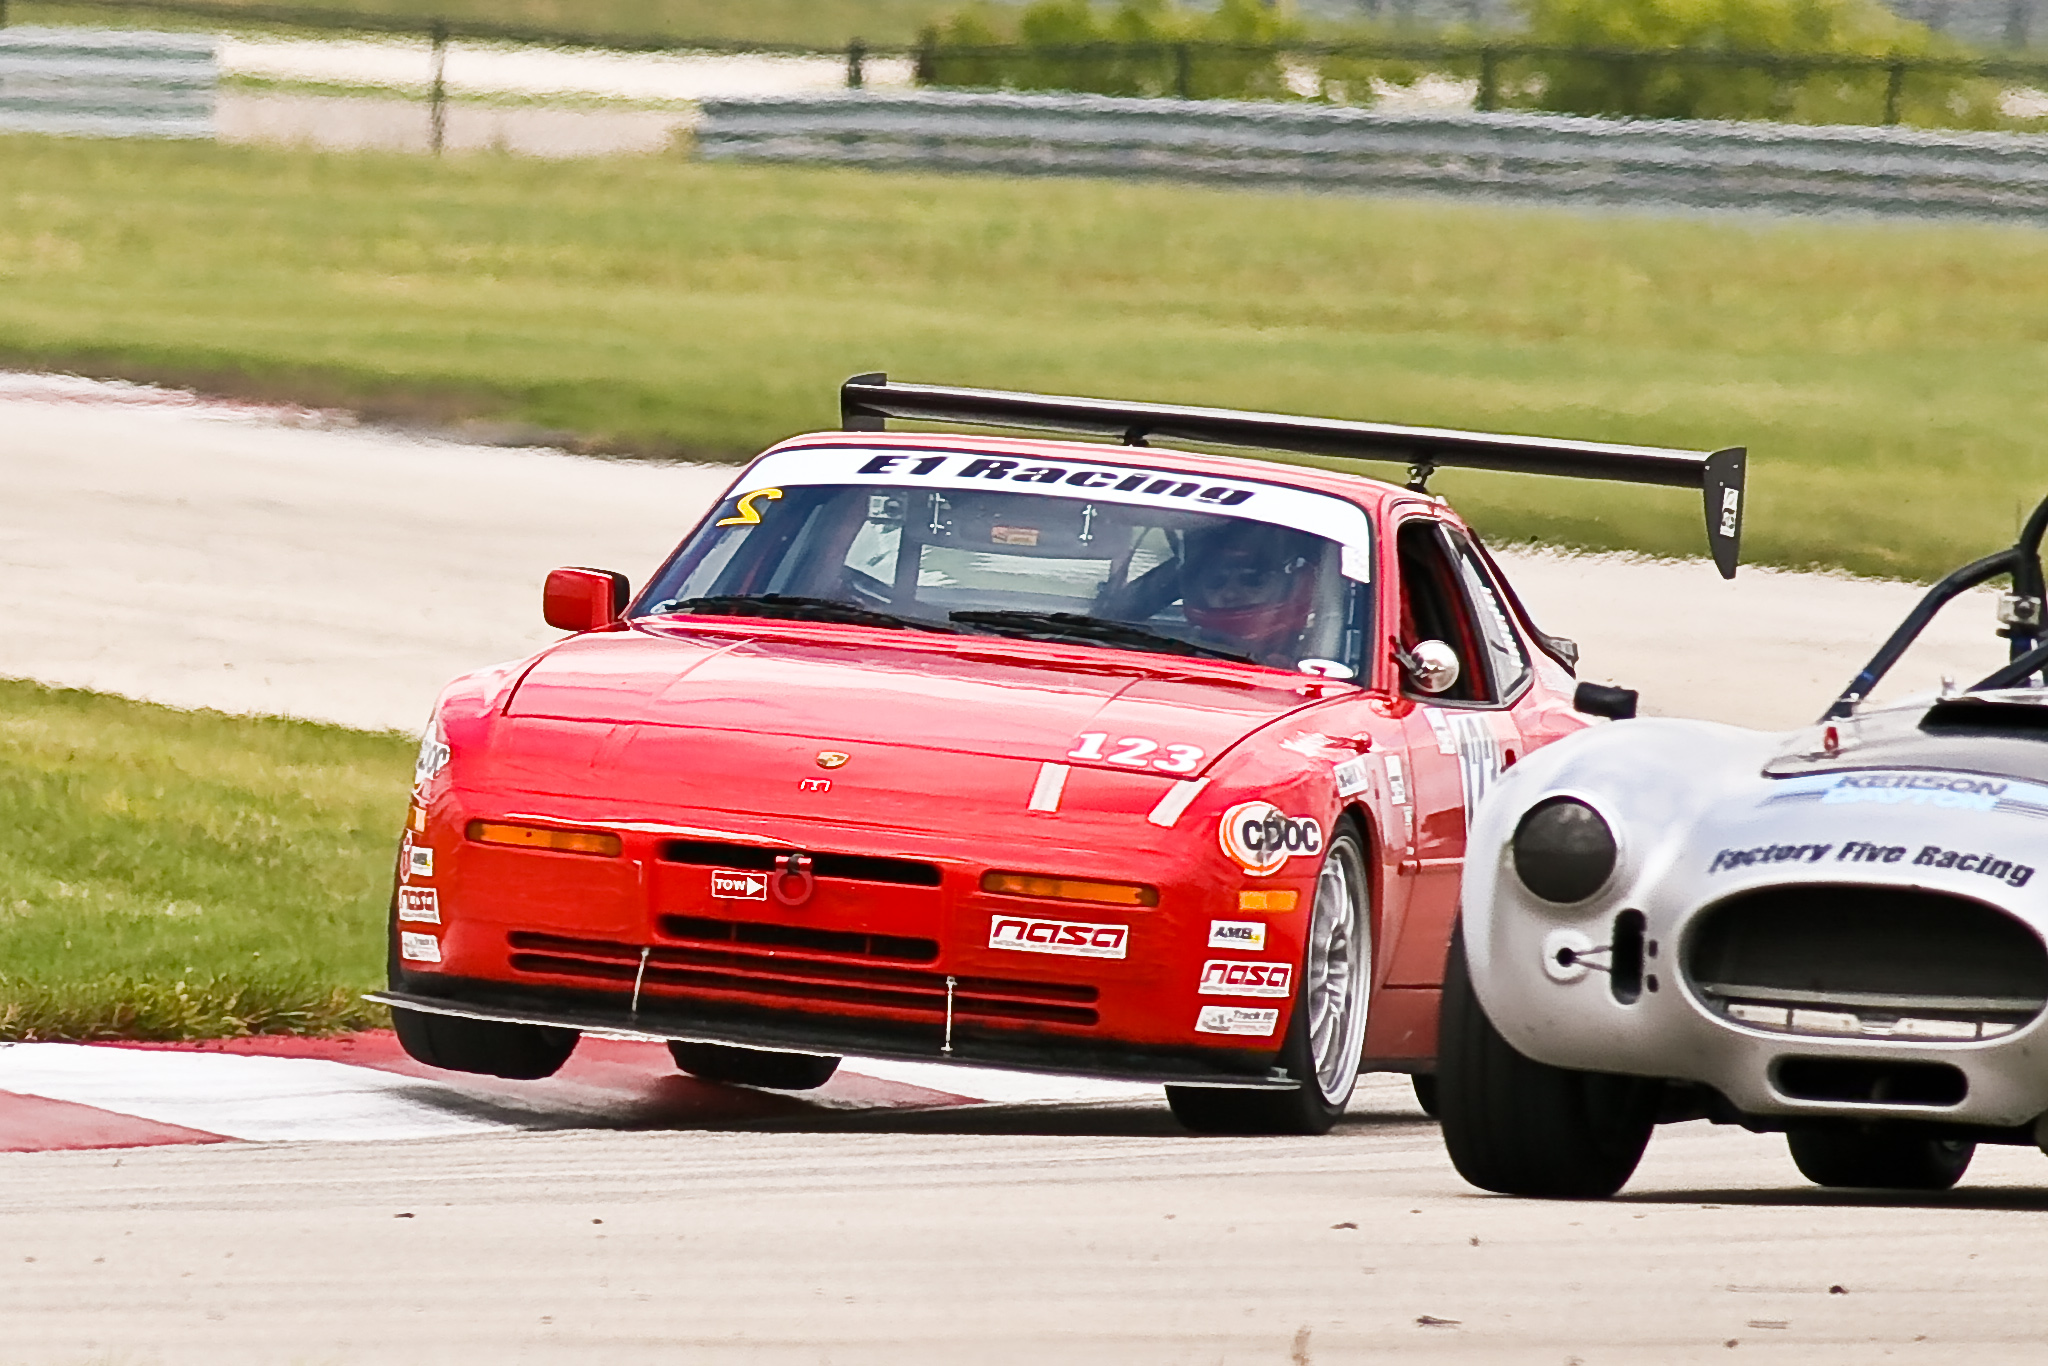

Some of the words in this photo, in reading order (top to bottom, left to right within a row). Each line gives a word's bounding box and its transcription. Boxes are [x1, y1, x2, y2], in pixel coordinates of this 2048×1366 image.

[857, 455, 949, 475] E1
[956, 458, 1256, 505] Racing
[1067, 732, 1205, 773] 123
[1708, 842, 1832, 874] Factory
[1836, 841, 1907, 863] Five
[1912, 845, 2036, 888] Racing
[714, 878, 746, 891] TOW
[993, 919, 1126, 949] nasa
[1200, 963, 1290, 988] nasa
